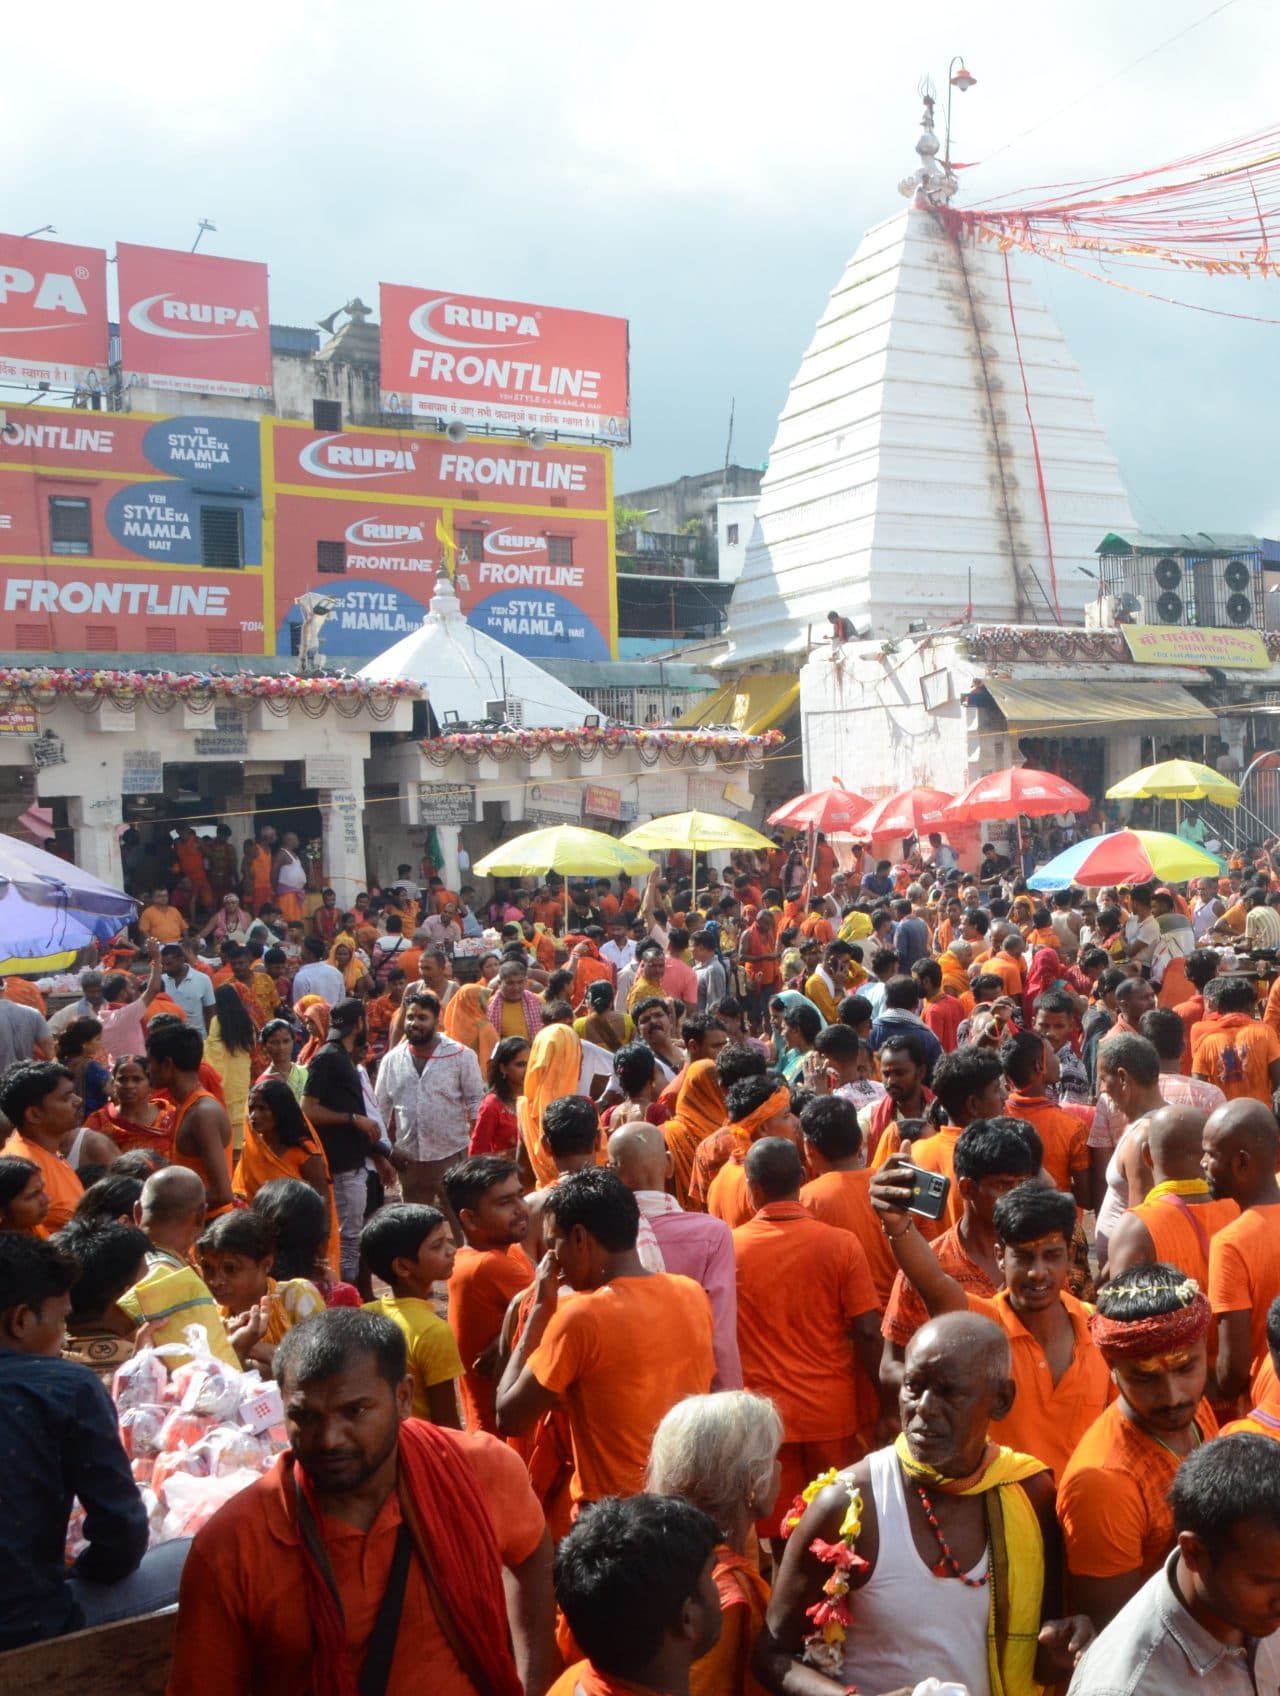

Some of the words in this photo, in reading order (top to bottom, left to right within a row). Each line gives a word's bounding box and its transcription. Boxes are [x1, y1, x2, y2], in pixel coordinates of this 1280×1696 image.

[162, 299, 259, 329] RUPA
[443, 304, 540, 337] RUPA
[409, 349, 601, 399] FRONTLINE
[513, 394, 541, 403] STYLE
[0, 422, 114, 453] ONTLINE
[168, 434, 217, 449] STYLE
[217, 441, 230, 450] KA
[170, 448, 230, 463] MAMLA
[327, 445, 416, 471] RUPA
[439, 454, 588, 492] FRONTLINE
[148, 494, 167, 505] YEH
[123, 505, 175, 522] STYLE
[175, 512, 189, 523] KA
[123, 522, 192, 540] MAMLA
[362, 523, 424, 541] RUPA
[498, 534, 547, 549] RUPA
[346, 554, 433, 572] FRONTLINE
[479, 562, 585, 587] FRONTLINE
[4, 579, 231, 616] FRONTLINE
[346, 591, 398, 611] STYLE
[490, 606, 508, 615] YEH
[508, 600, 556, 617] STYLE
[341, 611, 406, 631] MAMLA
[487, 617, 502, 626] KA
[503, 617, 565, 637] MAMLA
